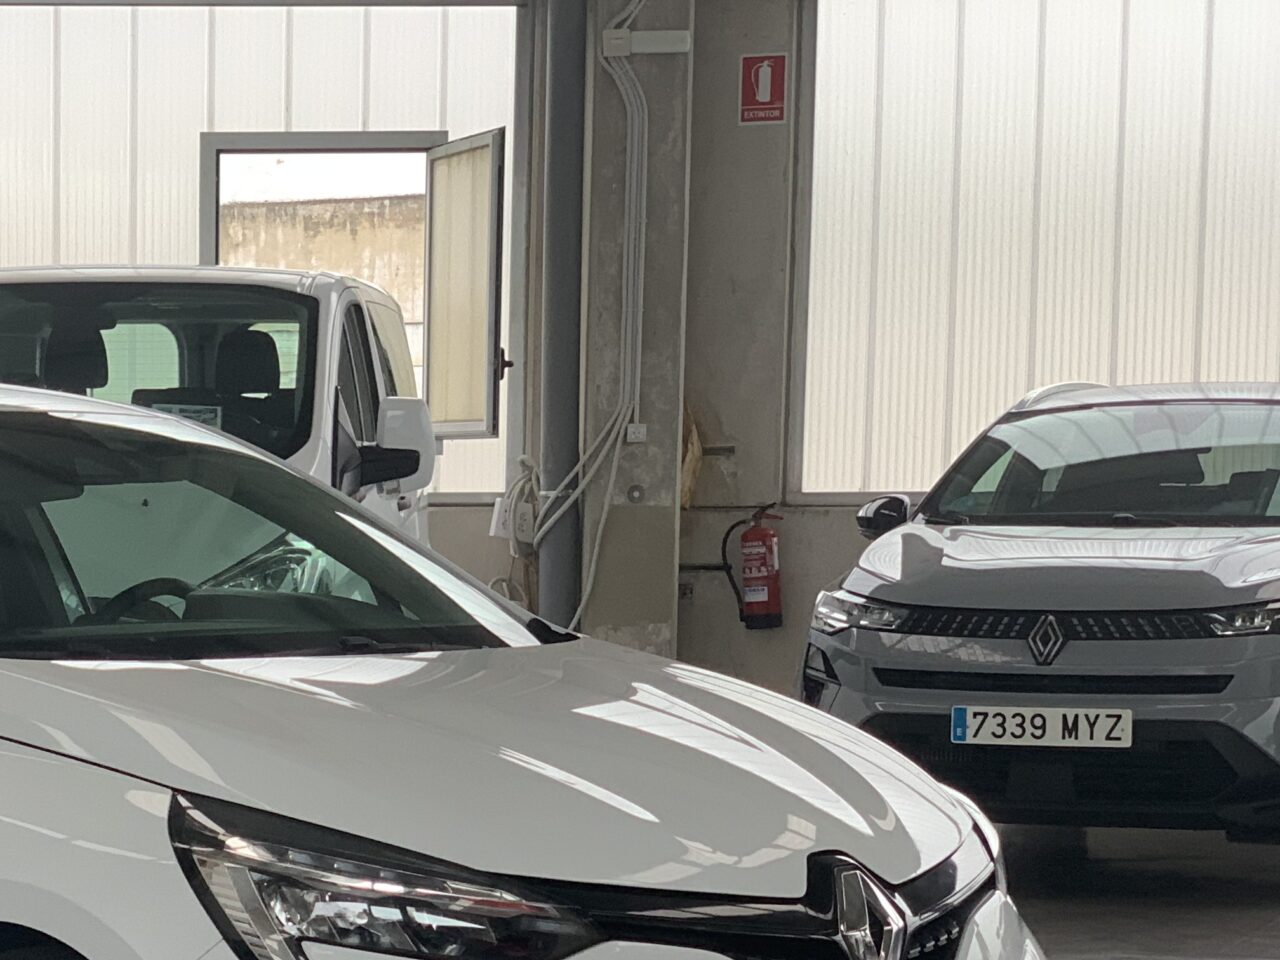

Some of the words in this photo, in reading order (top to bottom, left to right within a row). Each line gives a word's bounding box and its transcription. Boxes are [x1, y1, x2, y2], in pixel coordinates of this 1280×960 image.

[744, 110, 780, 119] EXTINTOR
[972, 712, 1047, 740] 7339
[1061, 713, 1122, 741] MYZ
